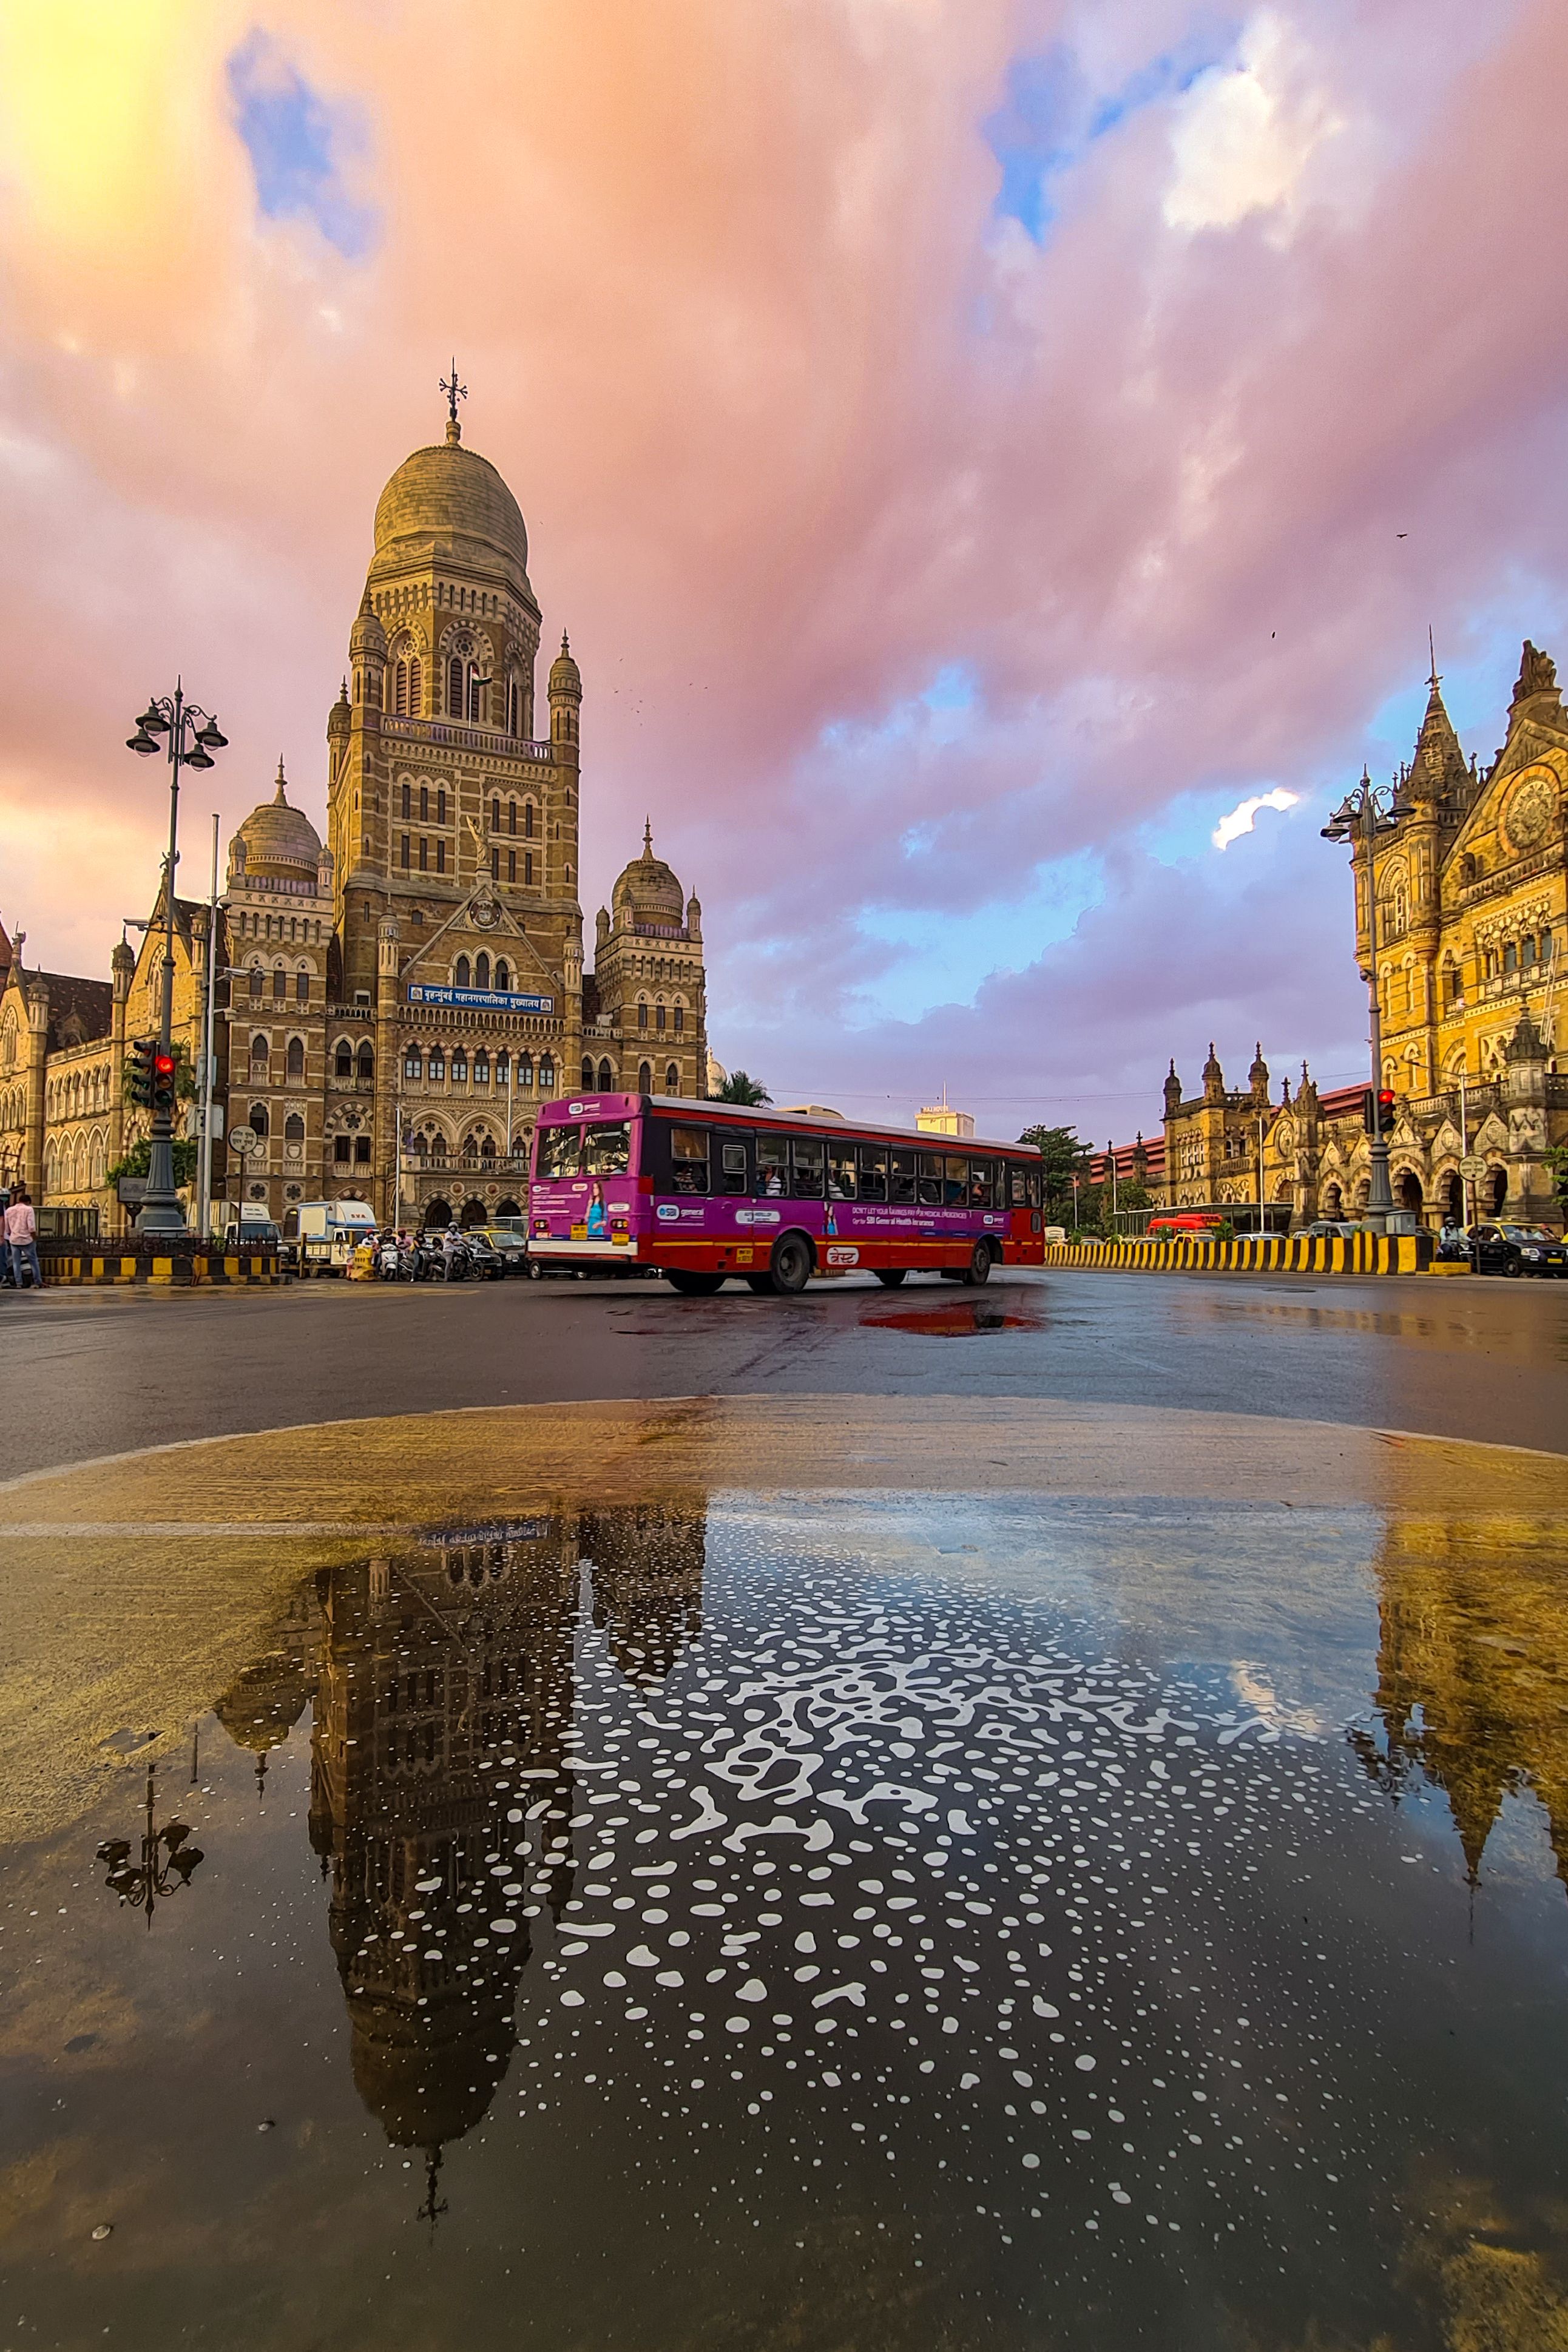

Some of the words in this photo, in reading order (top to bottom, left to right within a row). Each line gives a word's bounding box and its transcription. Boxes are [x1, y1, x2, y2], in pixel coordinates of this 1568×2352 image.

[425, 989, 453, 1002] बृहन्मुंबई
[455, 993, 508, 1005] महानगरपालिका
[510, 997, 539, 1009] मुख्यालय
[829, 1248, 856, 1263] बेस्ट
